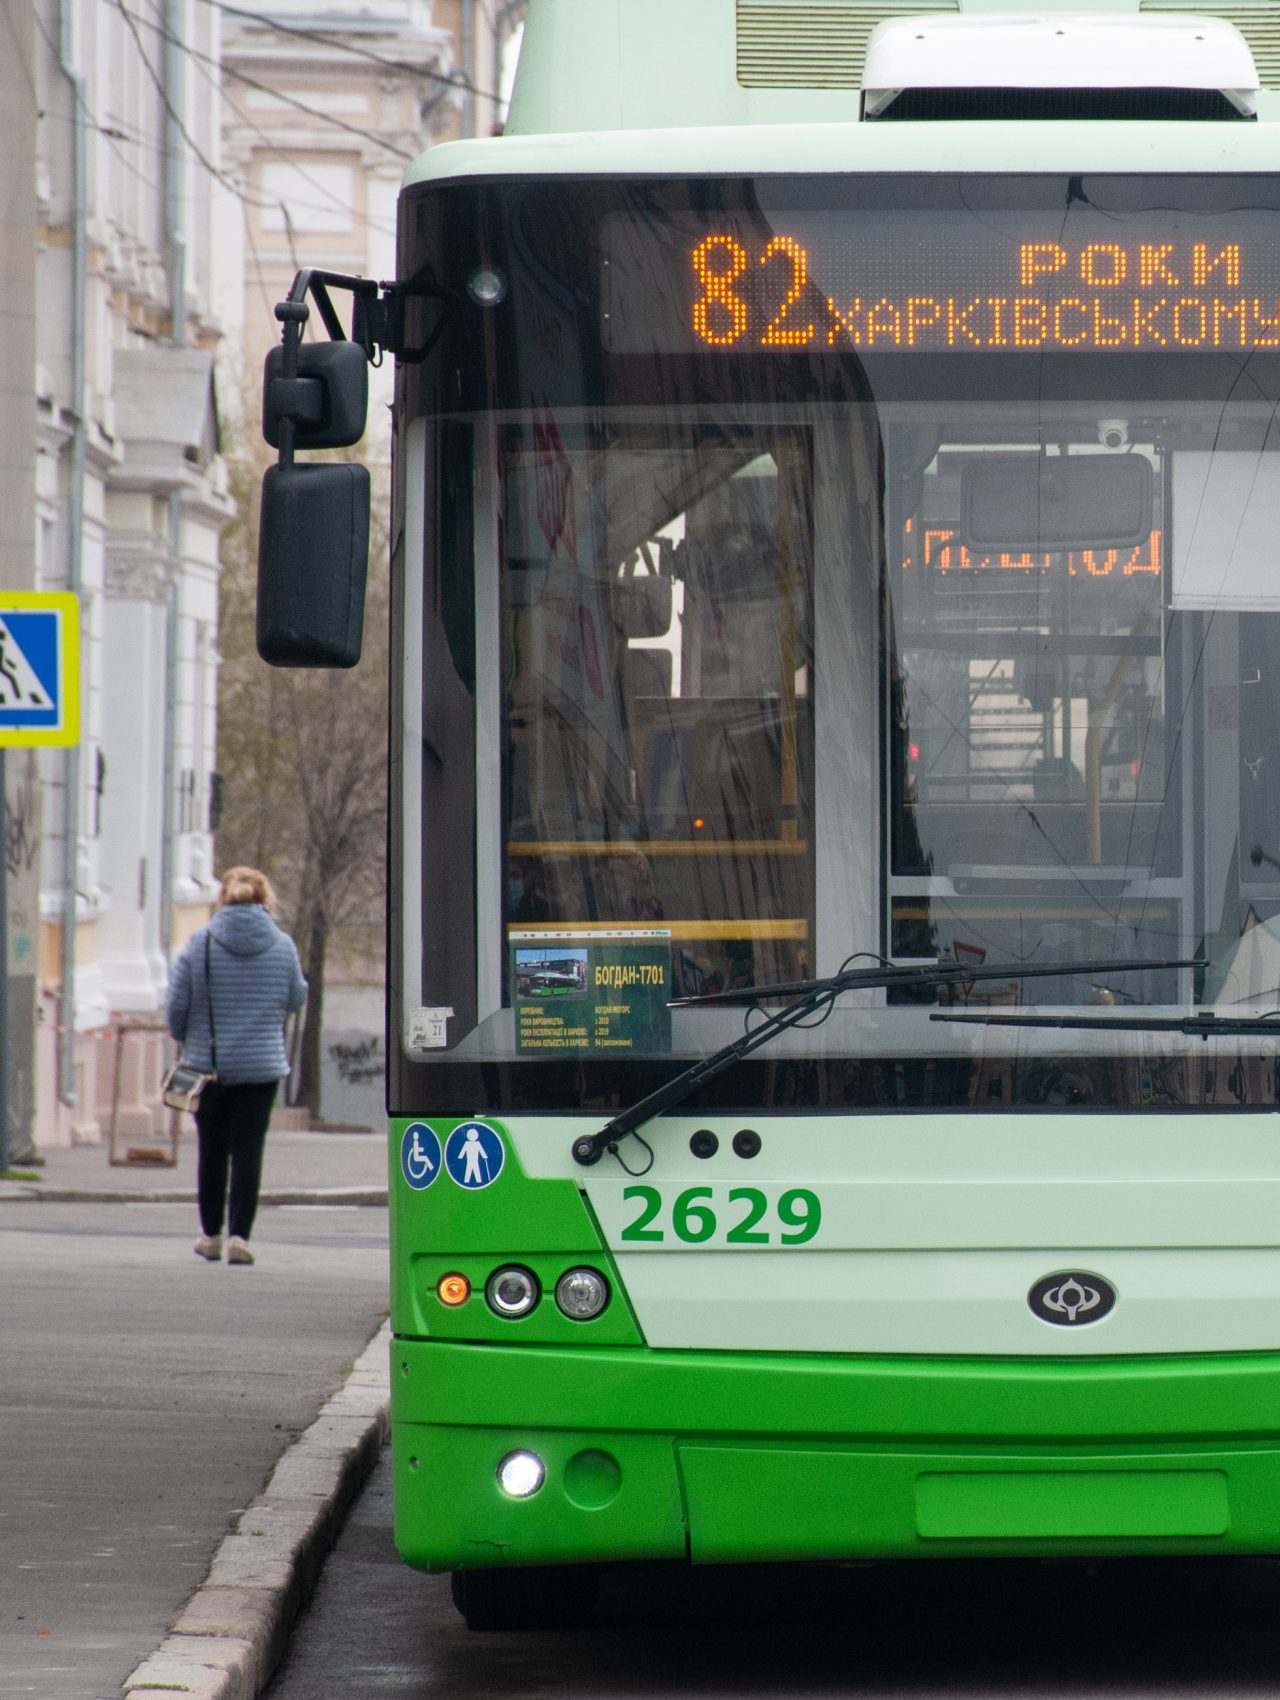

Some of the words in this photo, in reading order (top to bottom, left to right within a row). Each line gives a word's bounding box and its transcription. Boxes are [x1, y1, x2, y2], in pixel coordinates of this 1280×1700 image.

[691, 235, 814, 344] 82
[1019, 243, 1241, 287] РОКИ
[594, 965, 664, 988] БОГДАН-Т701
[620, 1186, 822, 1245] 2629
